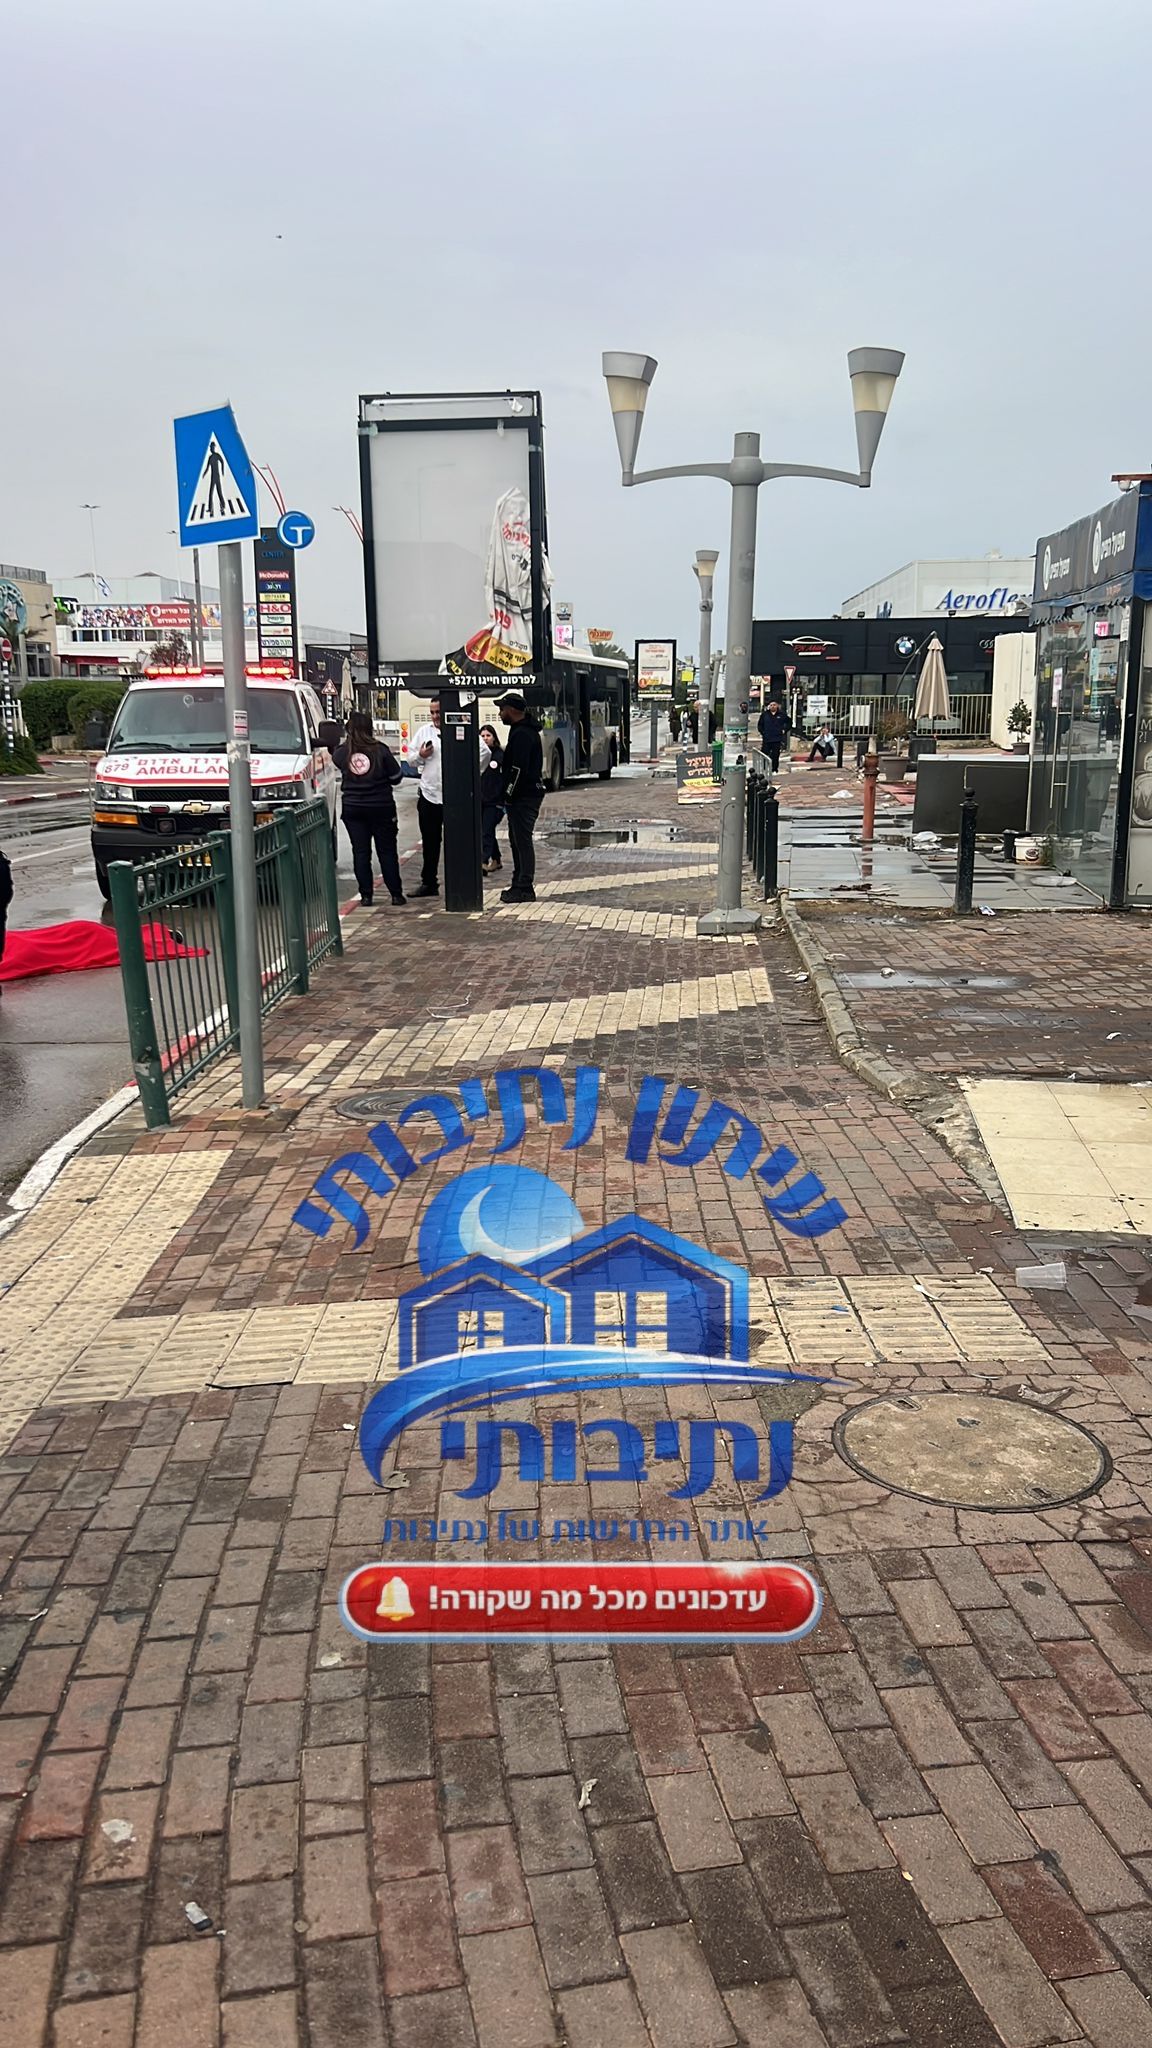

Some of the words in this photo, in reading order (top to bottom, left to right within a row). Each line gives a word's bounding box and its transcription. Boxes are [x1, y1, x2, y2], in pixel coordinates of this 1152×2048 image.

[935, 588, 1033, 610] Aerofle
[374, 677, 405, 687] 1037A
[478, 676, 500, 685] חייגו
[501, 675, 536, 685] לפרסום
[135, 765, 259, 776] AMBULANE
